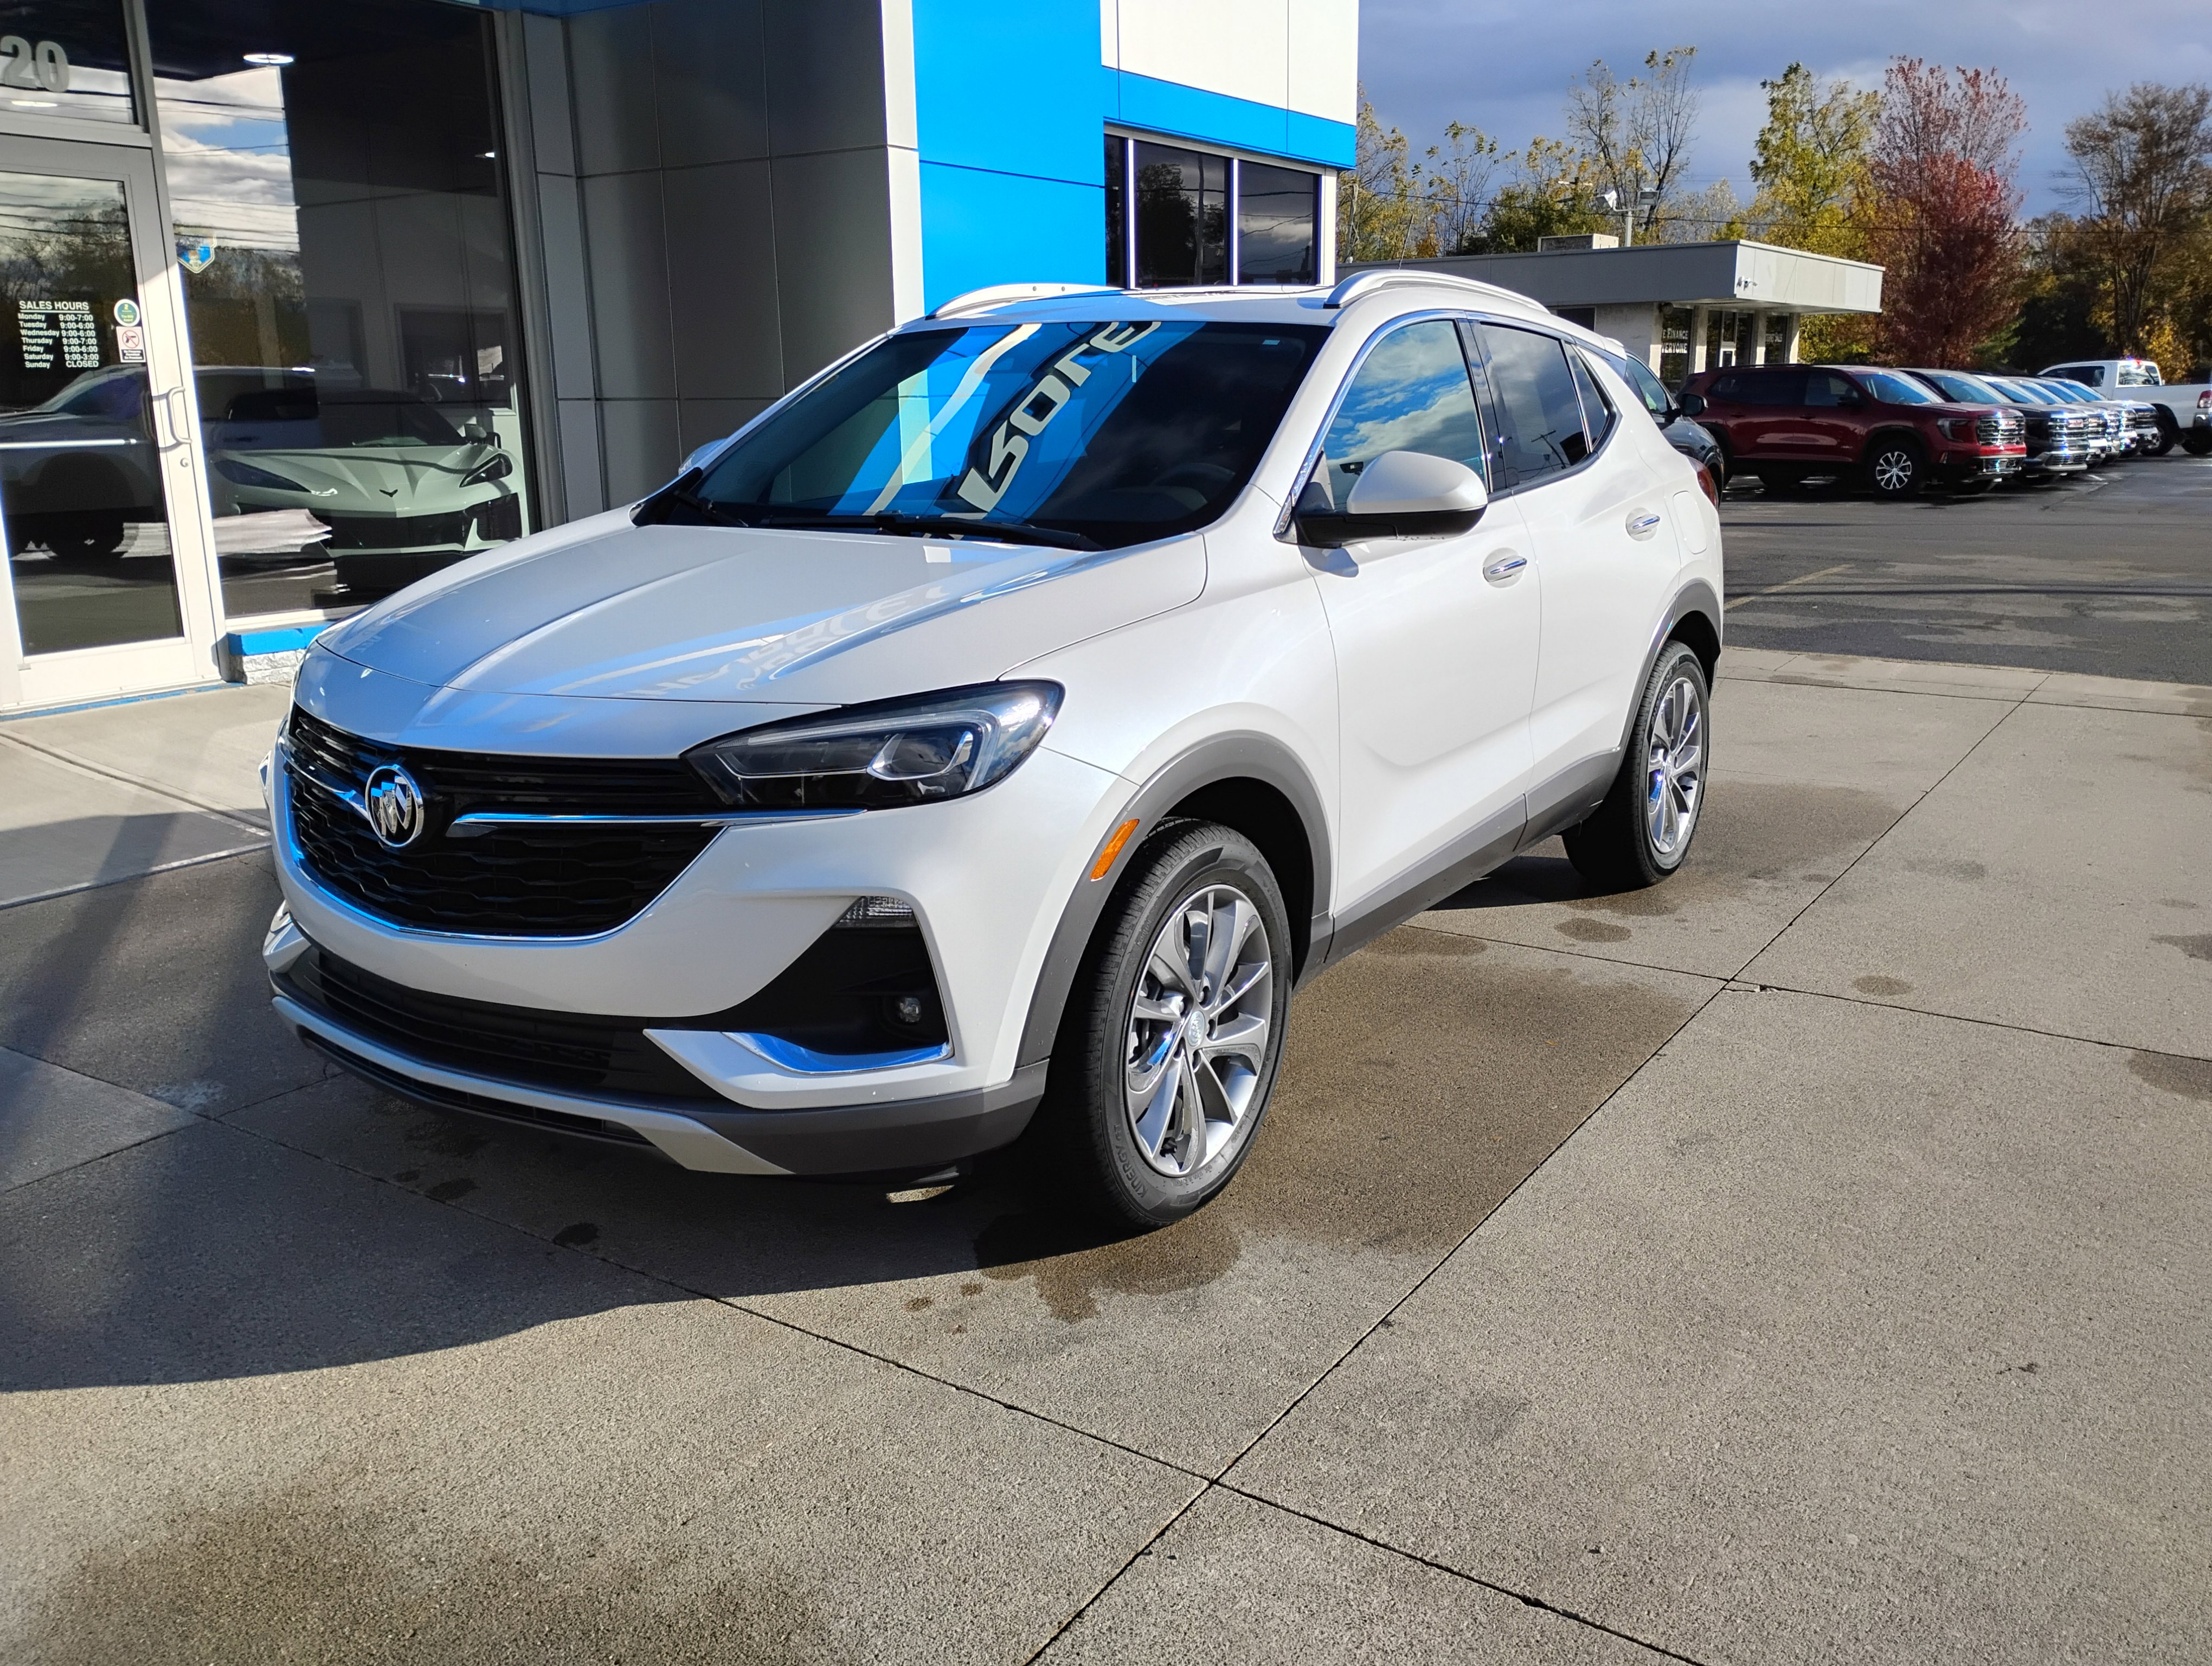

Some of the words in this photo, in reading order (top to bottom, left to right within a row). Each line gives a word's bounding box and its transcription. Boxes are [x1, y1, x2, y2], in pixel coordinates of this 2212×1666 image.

[1, 35, 69, 93] 20
[19, 300, 53, 310] SALES
[54, 302, 89, 310] HOURS
[18, 313, 45, 321] Monday
[19, 321, 47, 329] Tuesday
[20, 329, 60, 337] Wednesday
[1667, 328, 1688, 339] FINANCE
[1662, 342, 1688, 354] VERYONE
[24, 353, 53, 361] Saturday
[1116, 1145, 1148, 1198] KINERGY
